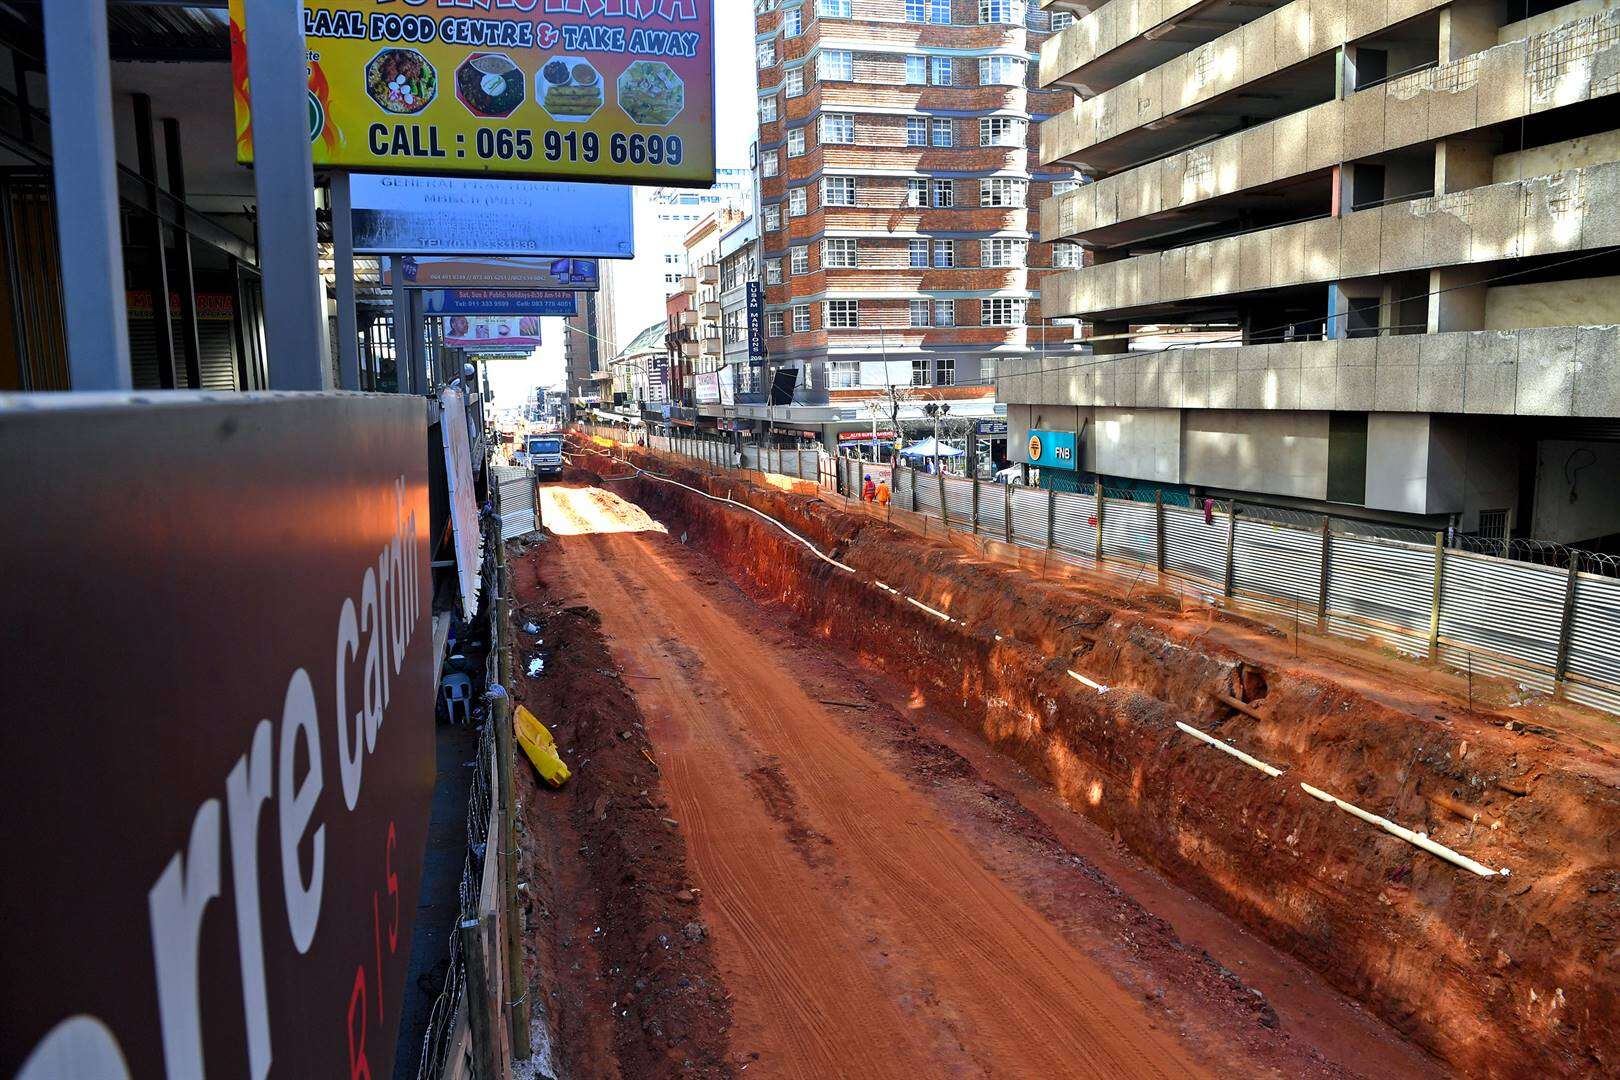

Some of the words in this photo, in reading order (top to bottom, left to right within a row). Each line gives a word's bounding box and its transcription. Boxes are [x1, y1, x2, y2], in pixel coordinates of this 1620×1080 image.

[305, 9, 367, 38] LAAL
[370, 13, 435, 41] FOOD
[439, 17, 533, 48] CENTRE
[536, 21, 558, 49] &
[563, 25, 625, 52] TAKE
[628, 29, 699, 57] AWAY
[368, 122, 447, 158] CALL
[456, 133, 466, 159] :
[476, 127, 533, 161] 065
[544, 129, 600, 162] 919
[609, 132, 684, 166] 6699
[419, 239, 442, 248] TEL
[749, 282, 758, 308] LUSAM
[750, 312, 760, 352] MANSIONS
[1055, 447, 1070, 459] FNB
[336, 474, 420, 812] cardin
